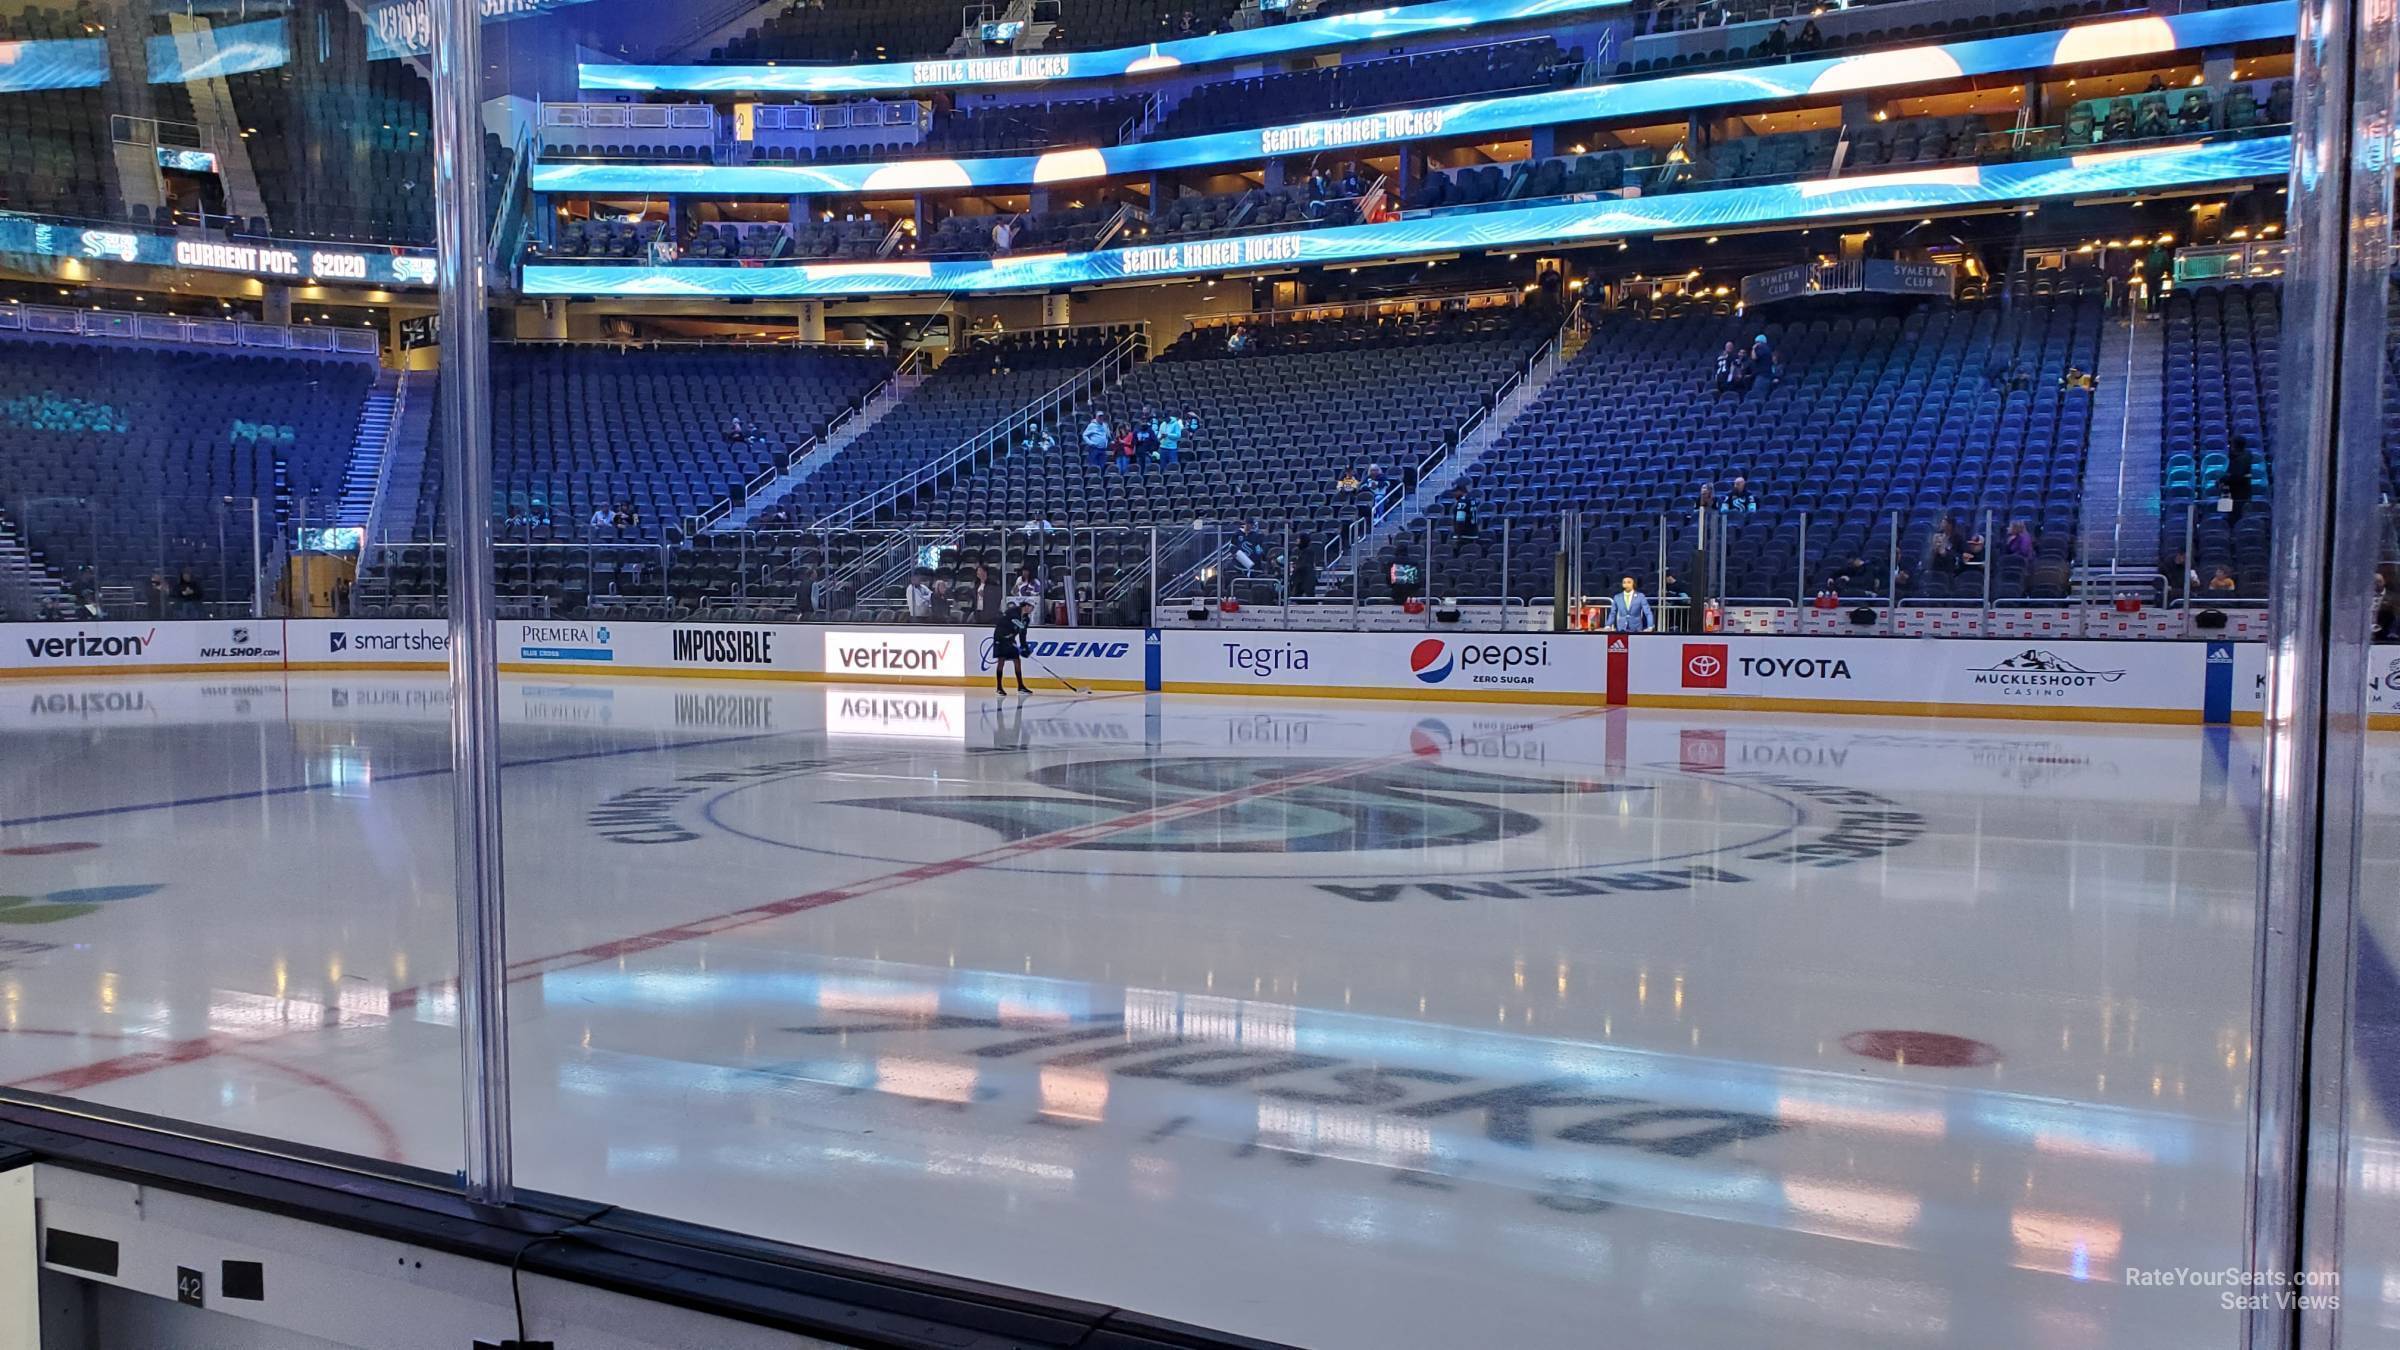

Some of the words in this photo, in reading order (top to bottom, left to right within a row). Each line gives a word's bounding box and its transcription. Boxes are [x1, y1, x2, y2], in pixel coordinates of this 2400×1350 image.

[913, 63, 963, 84] SEATTLE
[967, 60, 1017, 81] KRAKEN
[1019, 57, 1070, 79] HOCKEY
[1262, 126, 1319, 153] SEATTLE
[1323, 119, 1380, 145] KRAKEN
[1386, 109, 1443, 138] HOCKEY
[177, 241, 257, 270] CURRENT
[259, 249, 299, 274] POT:
[312, 252, 367, 278] $2020
[1122, 246, 1177, 273] SEATTLE
[1183, 240, 1239, 268] KRAKEN
[1245, 234, 1300, 262] HOCKEY
[1760, 270, 1799, 287] SYMETRA
[1893, 264, 1947, 277] SYMETRA
[1904, 276, 1934, 287] CLUB
[1768, 284, 1790, 295] CLUB
[26, 632, 142, 658] verizon
[522, 625, 589, 643] PREMERA
[673, 630, 772, 664] IMPOSSIBLE
[839, 642, 938, 669] verizon
[1461, 641, 1548, 671] pepsi
[1224, 643, 1309, 677] Tegria
[1739, 657, 1852, 680] TOYOTA
[1473, 675, 1498, 683] ZERO
[1500, 676, 1535, 684] SUGAR
[1974, 674, 2097, 686] MUCKLESHOOT
[2003, 687, 2065, 697] CASINO
[1310, 863, 1752, 902] ARENA
[180, 1276, 201, 1300] 42
